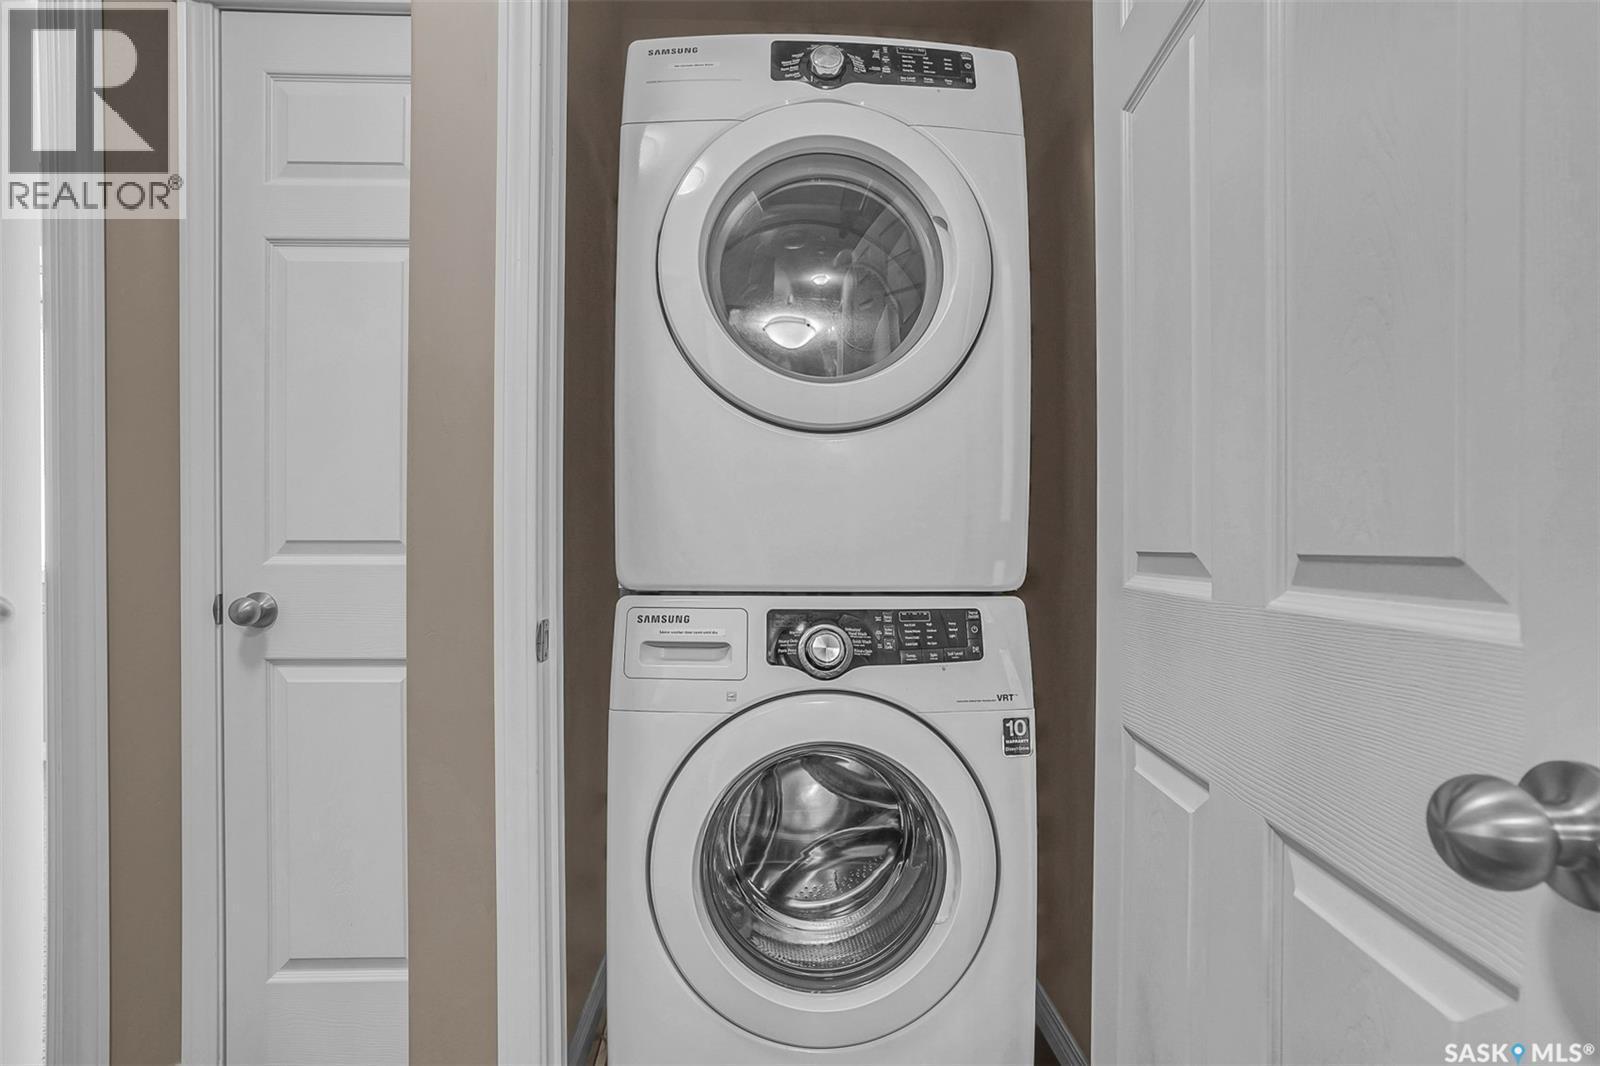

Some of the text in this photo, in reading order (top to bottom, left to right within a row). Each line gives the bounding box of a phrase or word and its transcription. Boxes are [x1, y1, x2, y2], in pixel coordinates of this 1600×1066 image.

[648, 47, 699, 56] SAMSUNG
[637, 614, 691, 624] SAMSUNG
[1005, 719, 1027, 737] 10
